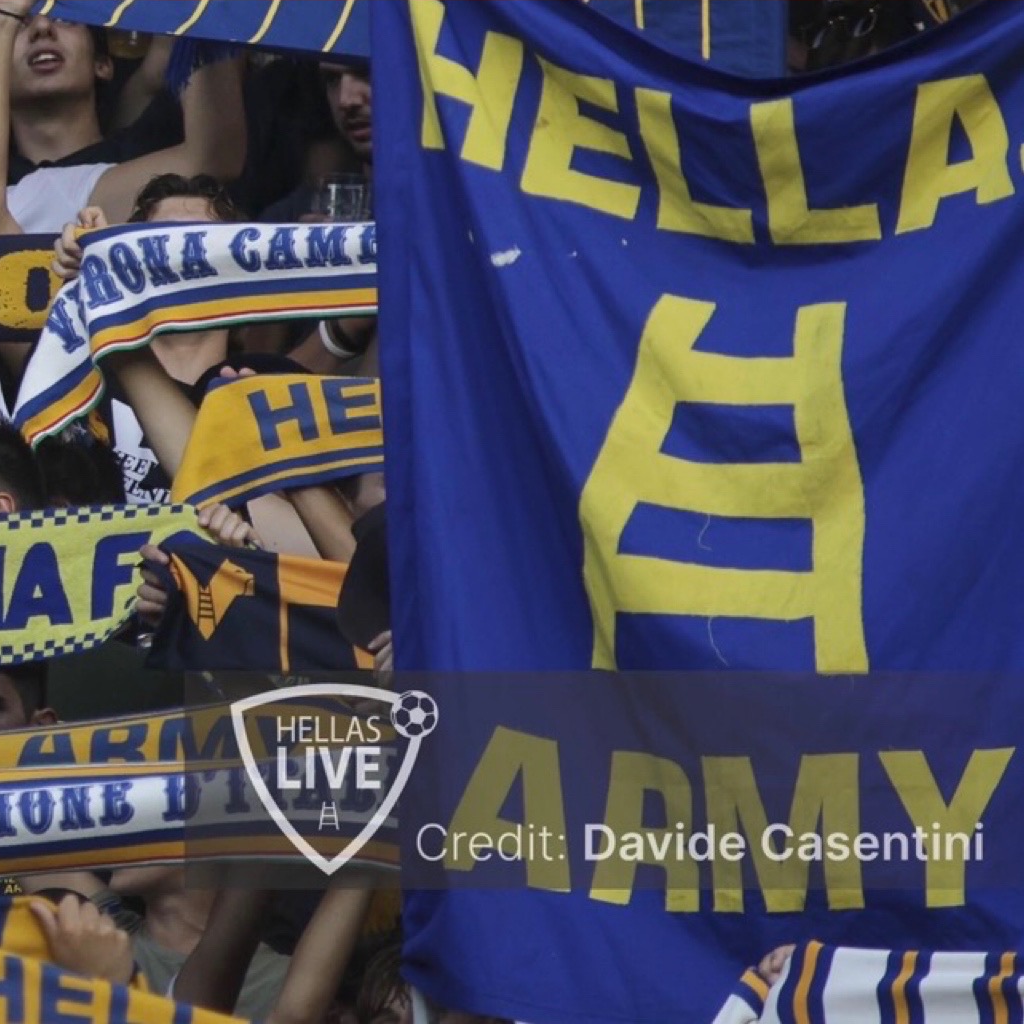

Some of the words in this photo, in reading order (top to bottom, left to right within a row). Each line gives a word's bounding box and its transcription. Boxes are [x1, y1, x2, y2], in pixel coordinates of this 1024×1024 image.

[409, 0, 1024, 245] HELLA
[247, 377, 383, 452] HE
[444, 725, 1017, 914] ARMY
